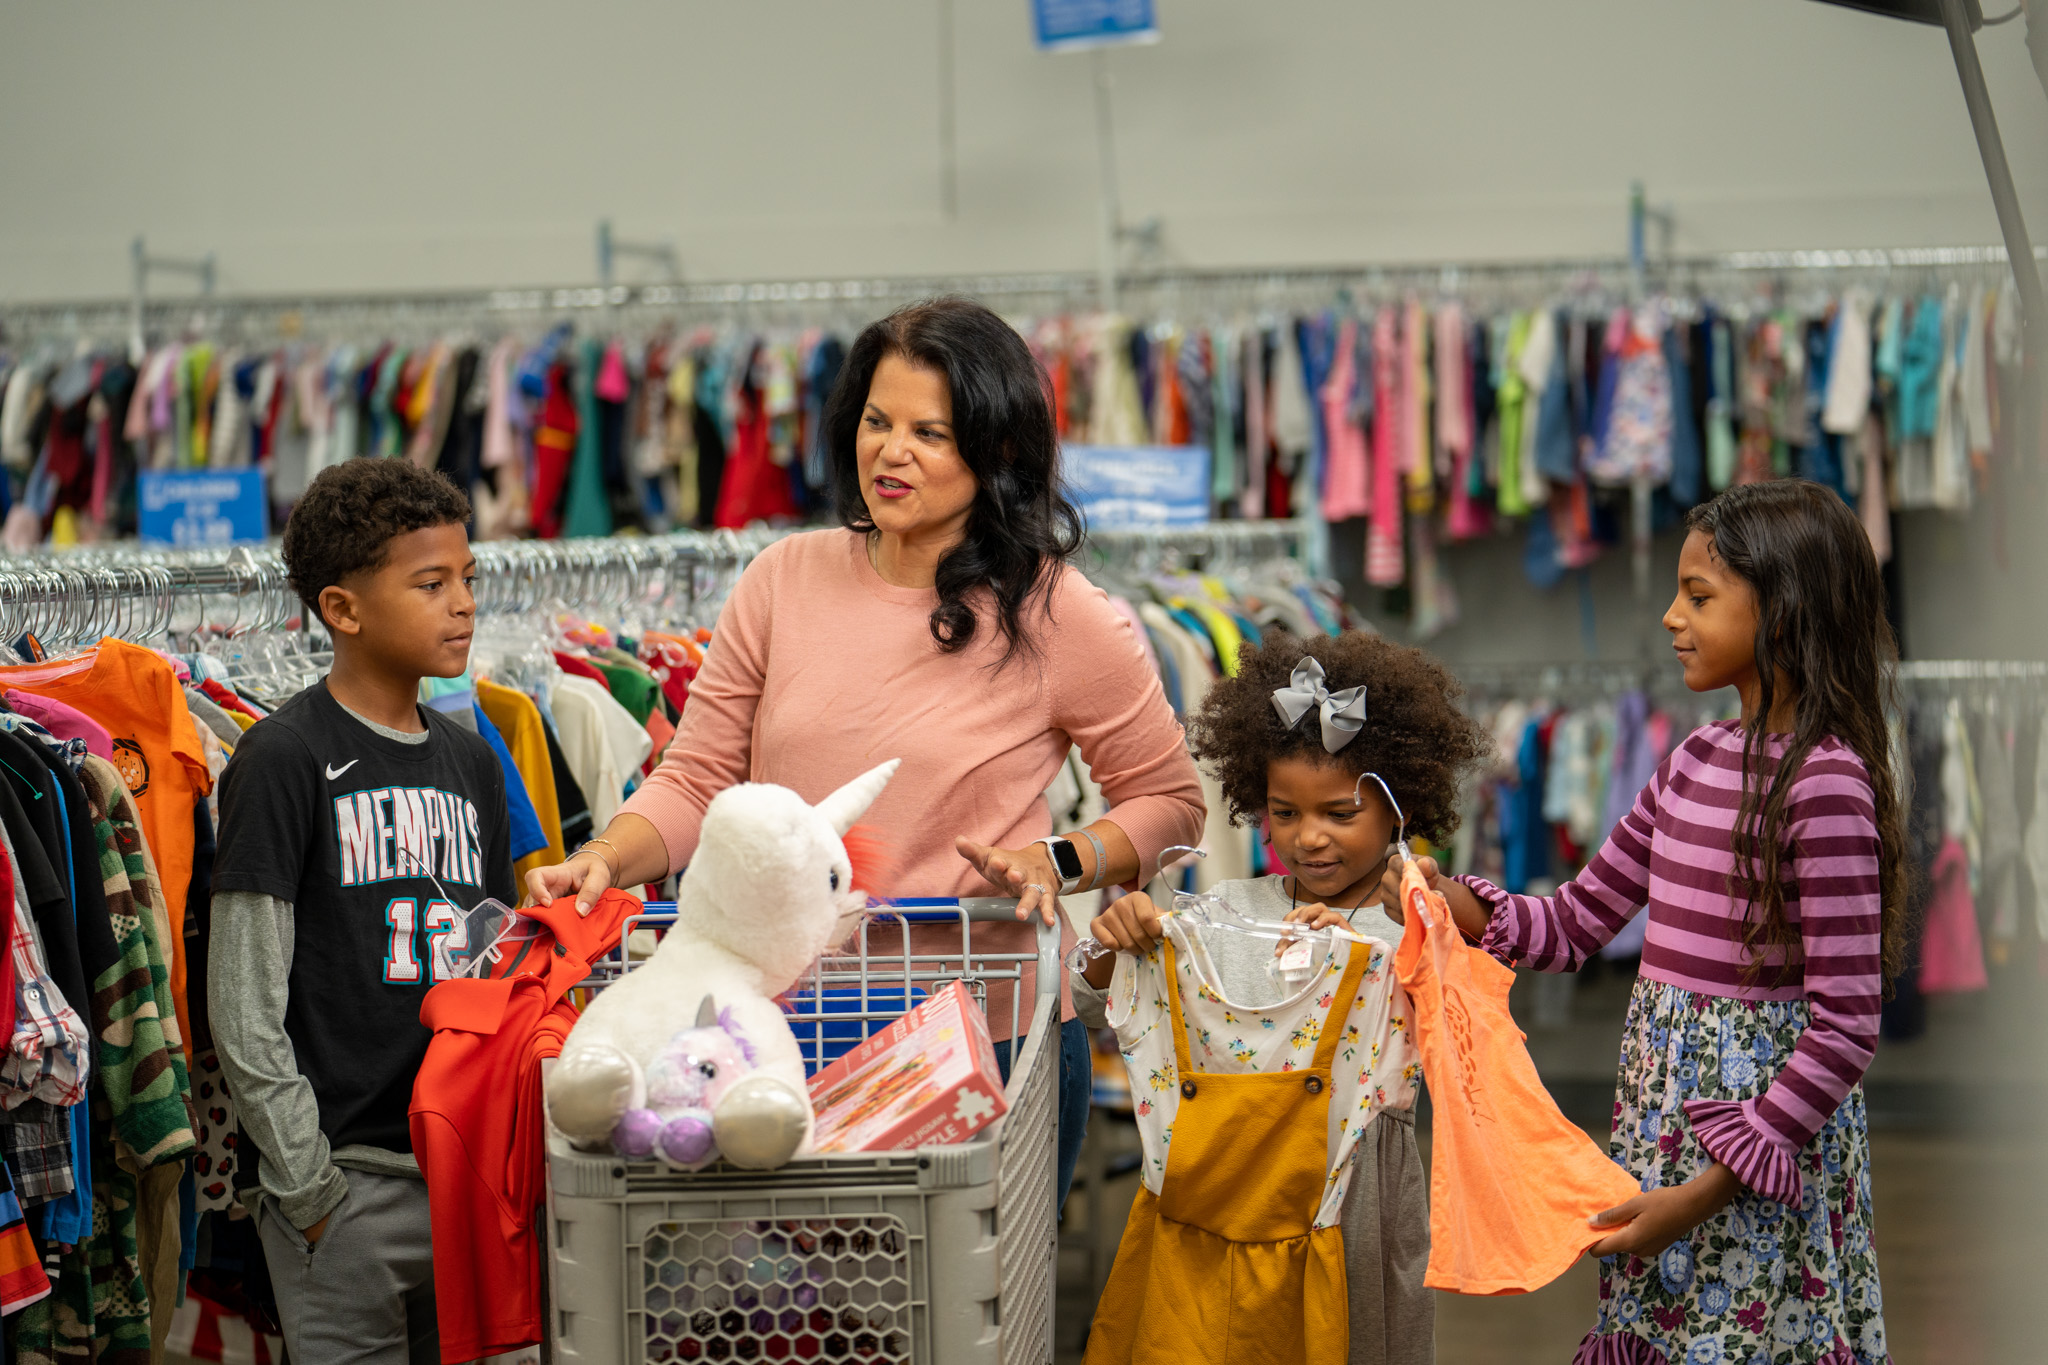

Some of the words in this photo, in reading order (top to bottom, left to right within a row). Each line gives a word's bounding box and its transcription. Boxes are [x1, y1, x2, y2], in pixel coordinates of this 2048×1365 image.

[333, 785, 482, 890] MEMPHIS
[382, 896, 471, 986] 12
[920, 984, 959, 1023] 500
